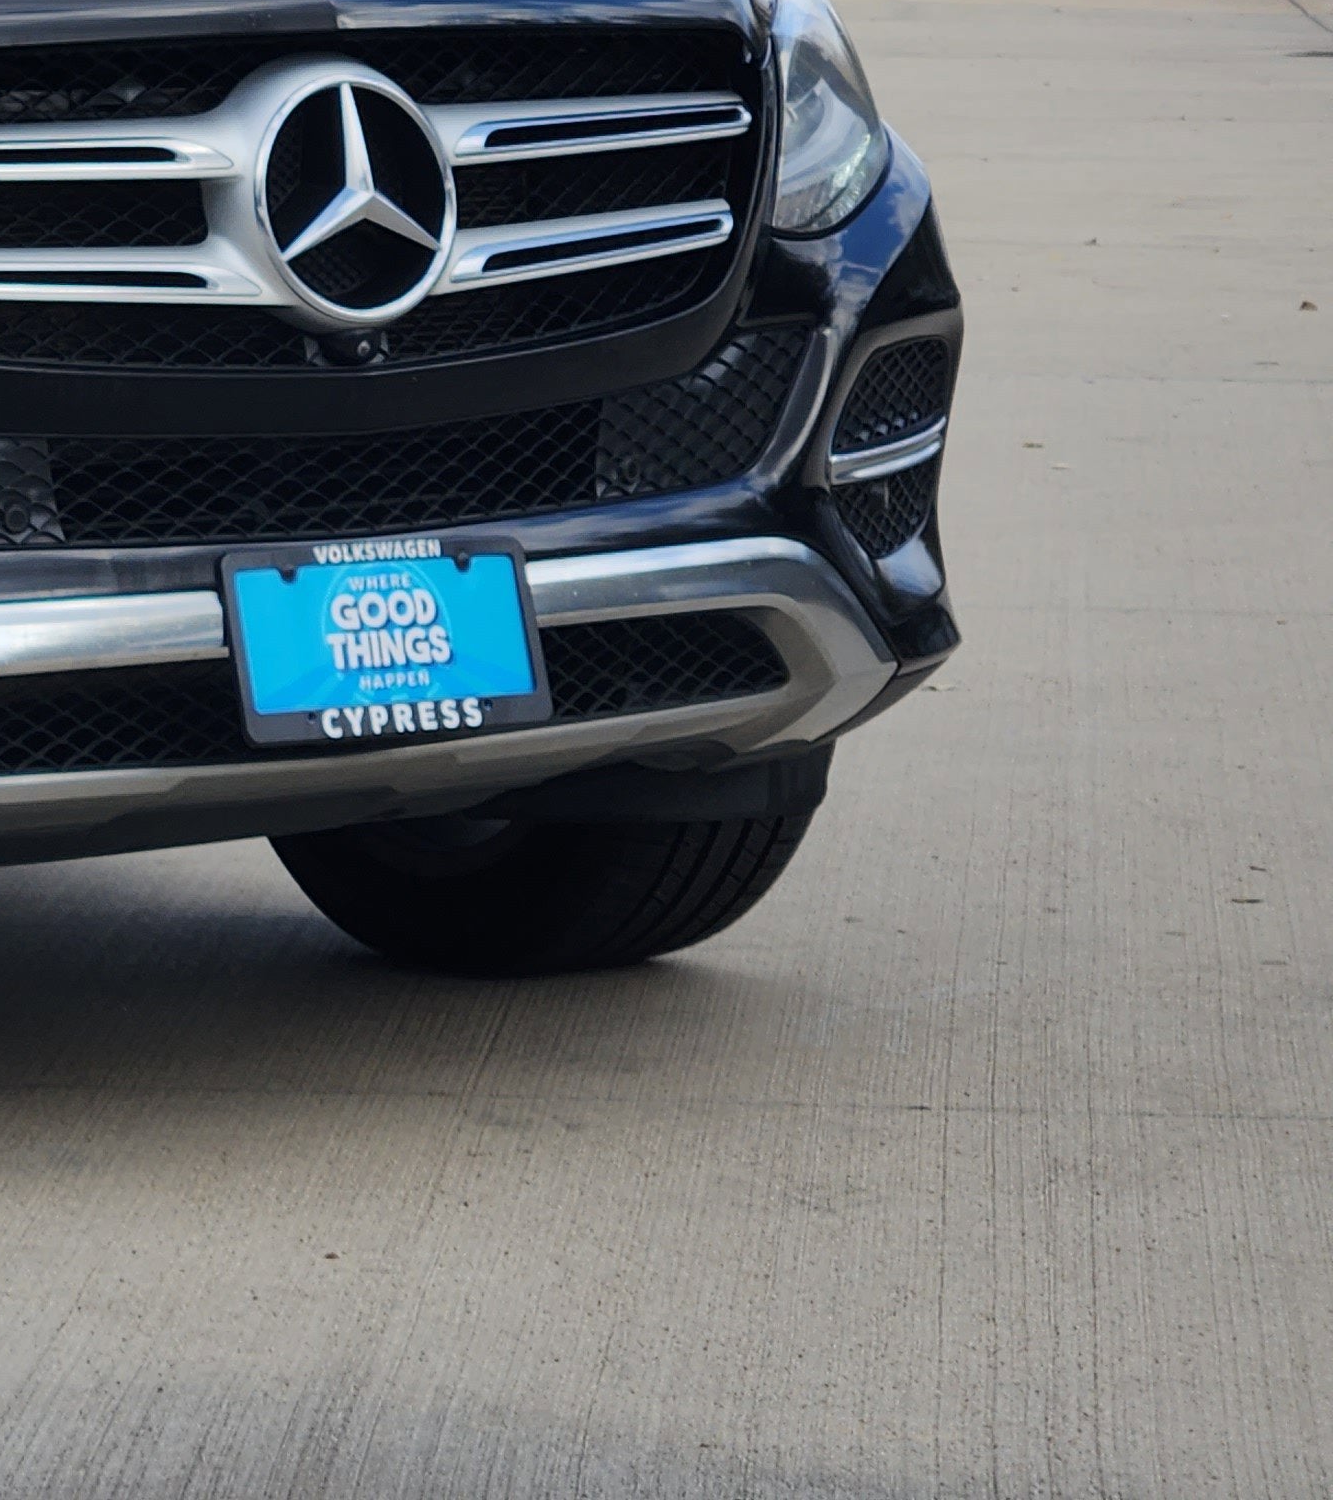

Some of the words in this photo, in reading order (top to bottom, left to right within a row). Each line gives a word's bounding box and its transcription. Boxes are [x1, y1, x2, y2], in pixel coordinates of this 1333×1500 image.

[313, 539, 441, 564] VOLKSWAGEN
[349, 571, 412, 591] WHERE
[330, 588, 436, 629] GOOD
[326, 625, 451, 670] THINGS
[359, 668, 430, 690] HAPPEN
[321, 696, 483, 739] CYPRESS
